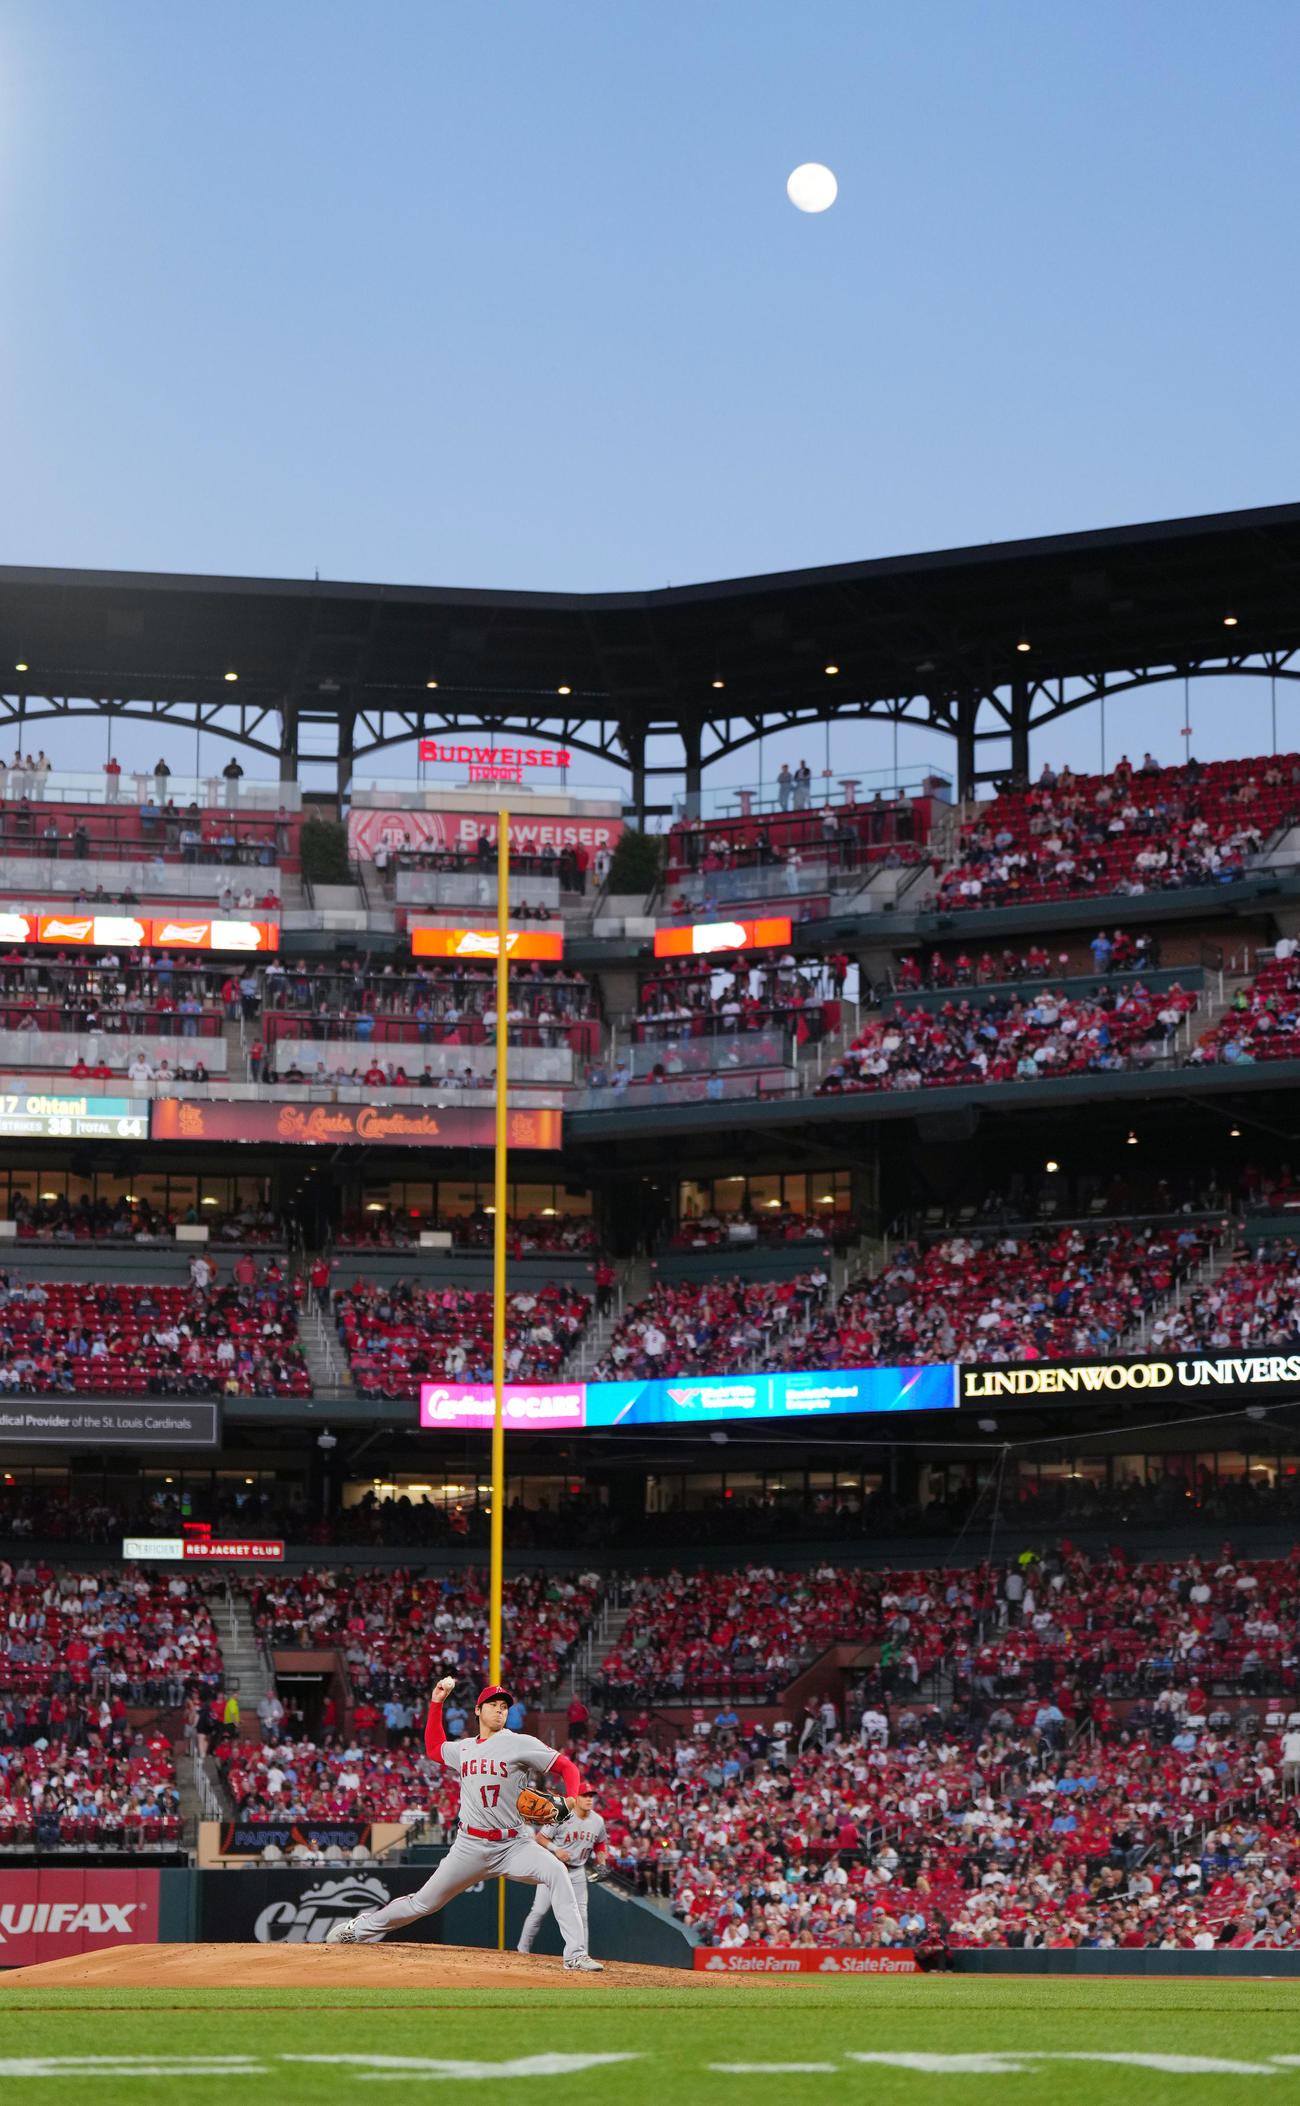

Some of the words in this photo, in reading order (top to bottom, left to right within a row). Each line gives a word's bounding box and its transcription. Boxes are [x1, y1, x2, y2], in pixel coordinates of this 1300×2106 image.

[419, 740, 571, 768] BUDWEISER
[26, 1096, 87, 1115] Ohtani
[48, 1118, 72, 1136] 38
[80, 1121, 112, 1134] TOTAL
[117, 1119, 141, 1137] 64
[356, 1107, 440, 1138] Cardinals
[964, 1363, 1174, 1397] LINDENWOOD
[1177, 1356, 1300, 1386] UNIVERS
[25, 1414, 70, 1427] Provider
[71, 1415, 83, 1428] of
[83, 1416, 101, 1428] the
[116, 1416, 143, 1429] Louis
[145, 1417, 192, 1430] Cardinals
[186, 1544, 208, 1555] RED
[209, 1545, 250, 1555] JACKET
[252, 1545, 281, 1556] CLUB
[480, 1784, 501, 1808] 17
[235, 1831, 290, 1846] PARTY
[308, 1831, 359, 1846] PATIO
[0, 1903, 138, 1943] UIFAX
